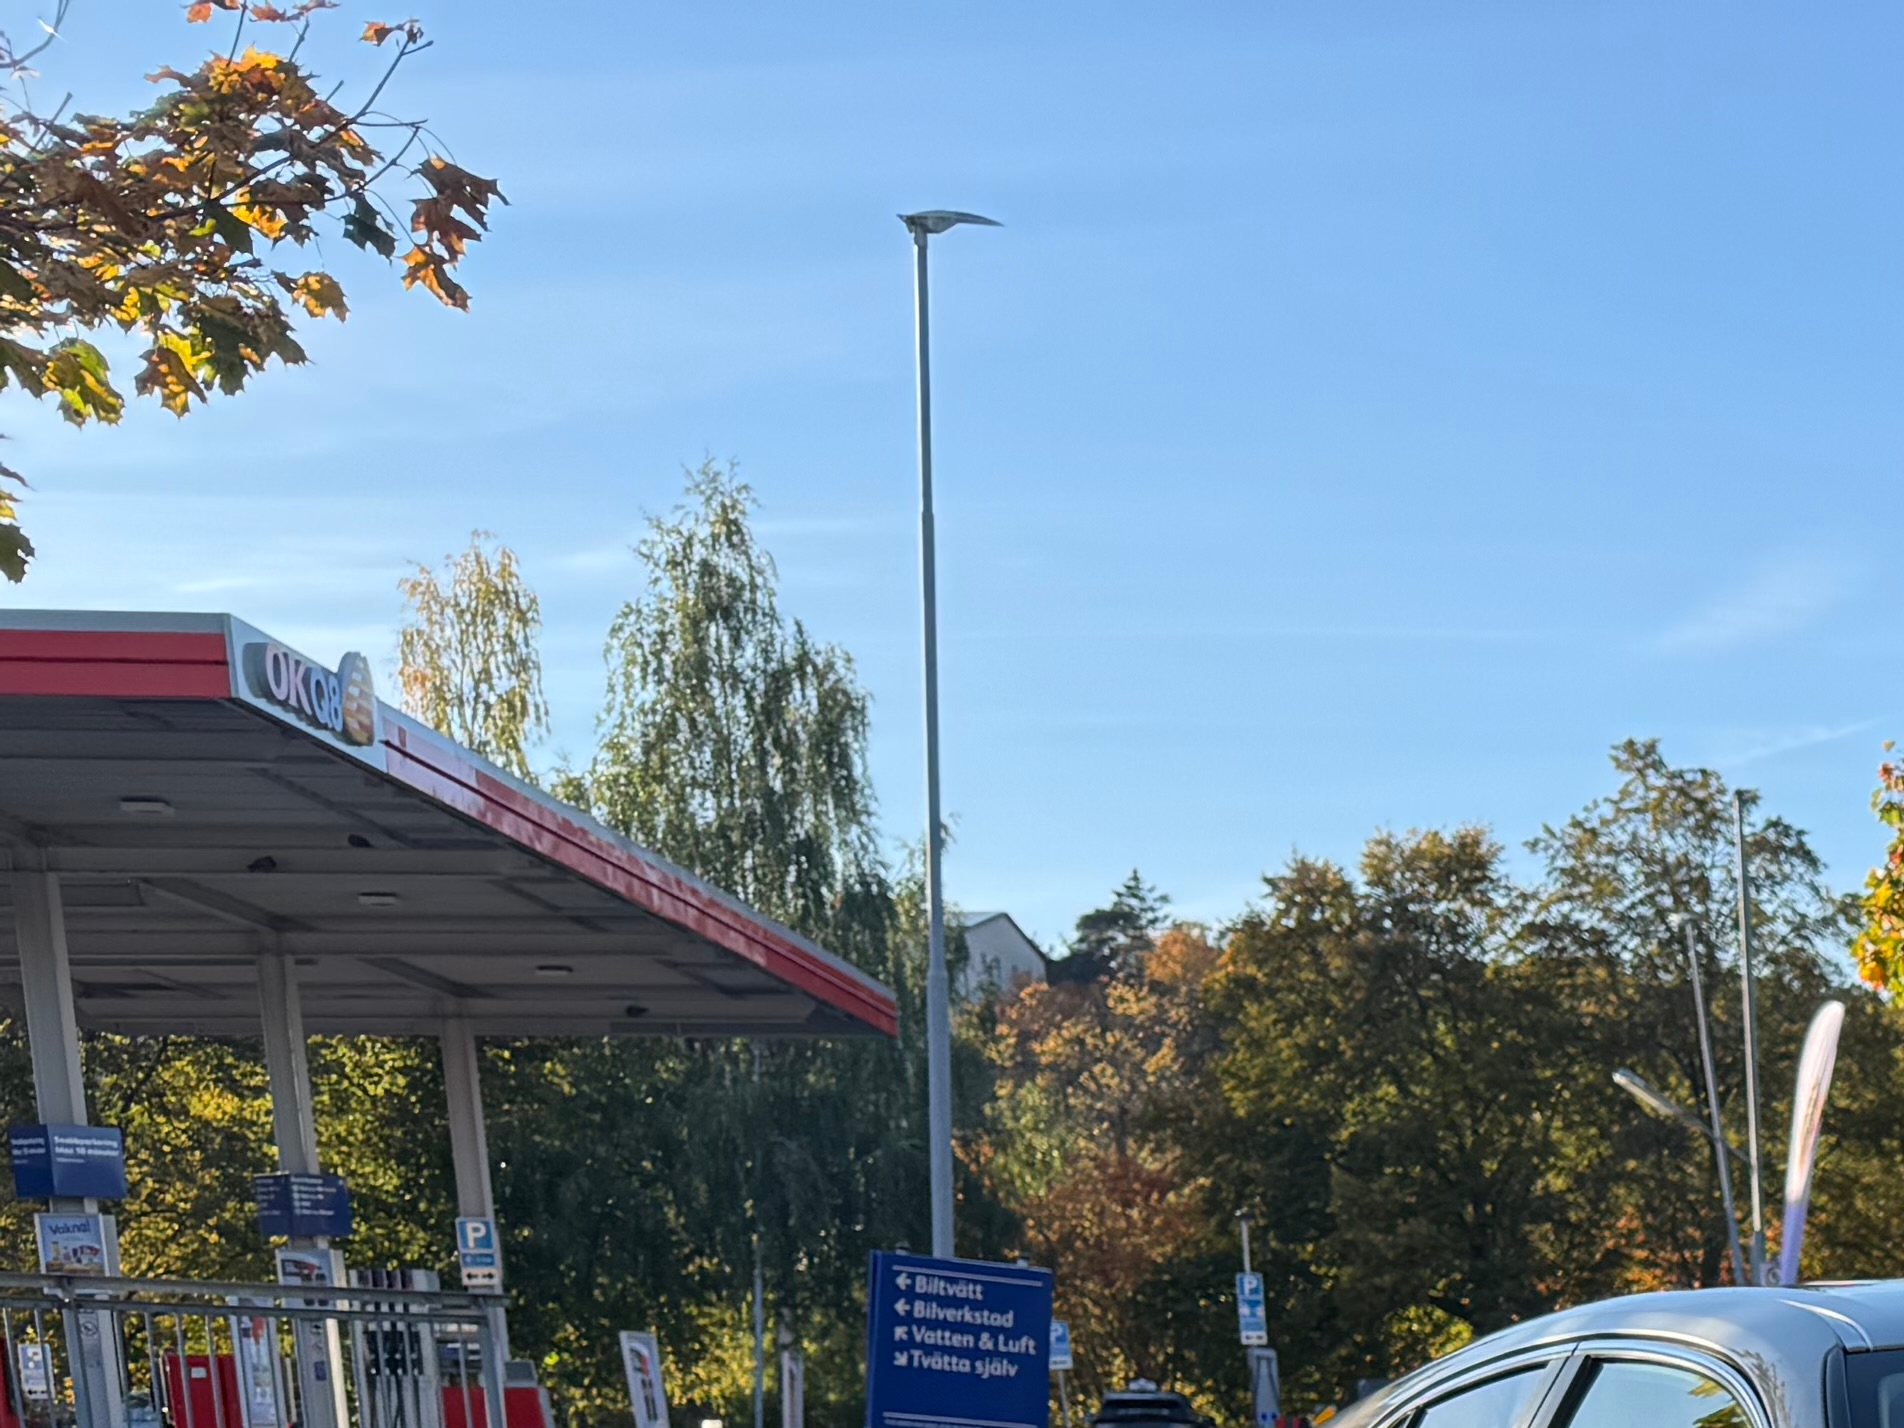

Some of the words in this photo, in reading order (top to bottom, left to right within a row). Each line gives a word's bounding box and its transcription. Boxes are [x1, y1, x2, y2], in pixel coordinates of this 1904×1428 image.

[265, 643, 343, 732] OKQ8
[466, 1222, 486, 1249] P
[915, 1274, 984, 1300] Biltvätt
[1243, 1278, 1257, 1295] P
[913, 1299, 1014, 1329] Bilverkstad
[912, 1324, 975, 1349] Vatten
[978, 1331, 994, 1351] &
[998, 1333, 1037, 1355] Luft
[909, 1348, 971, 1374] Tvätta
[975, 1356, 1019, 1379] själv
